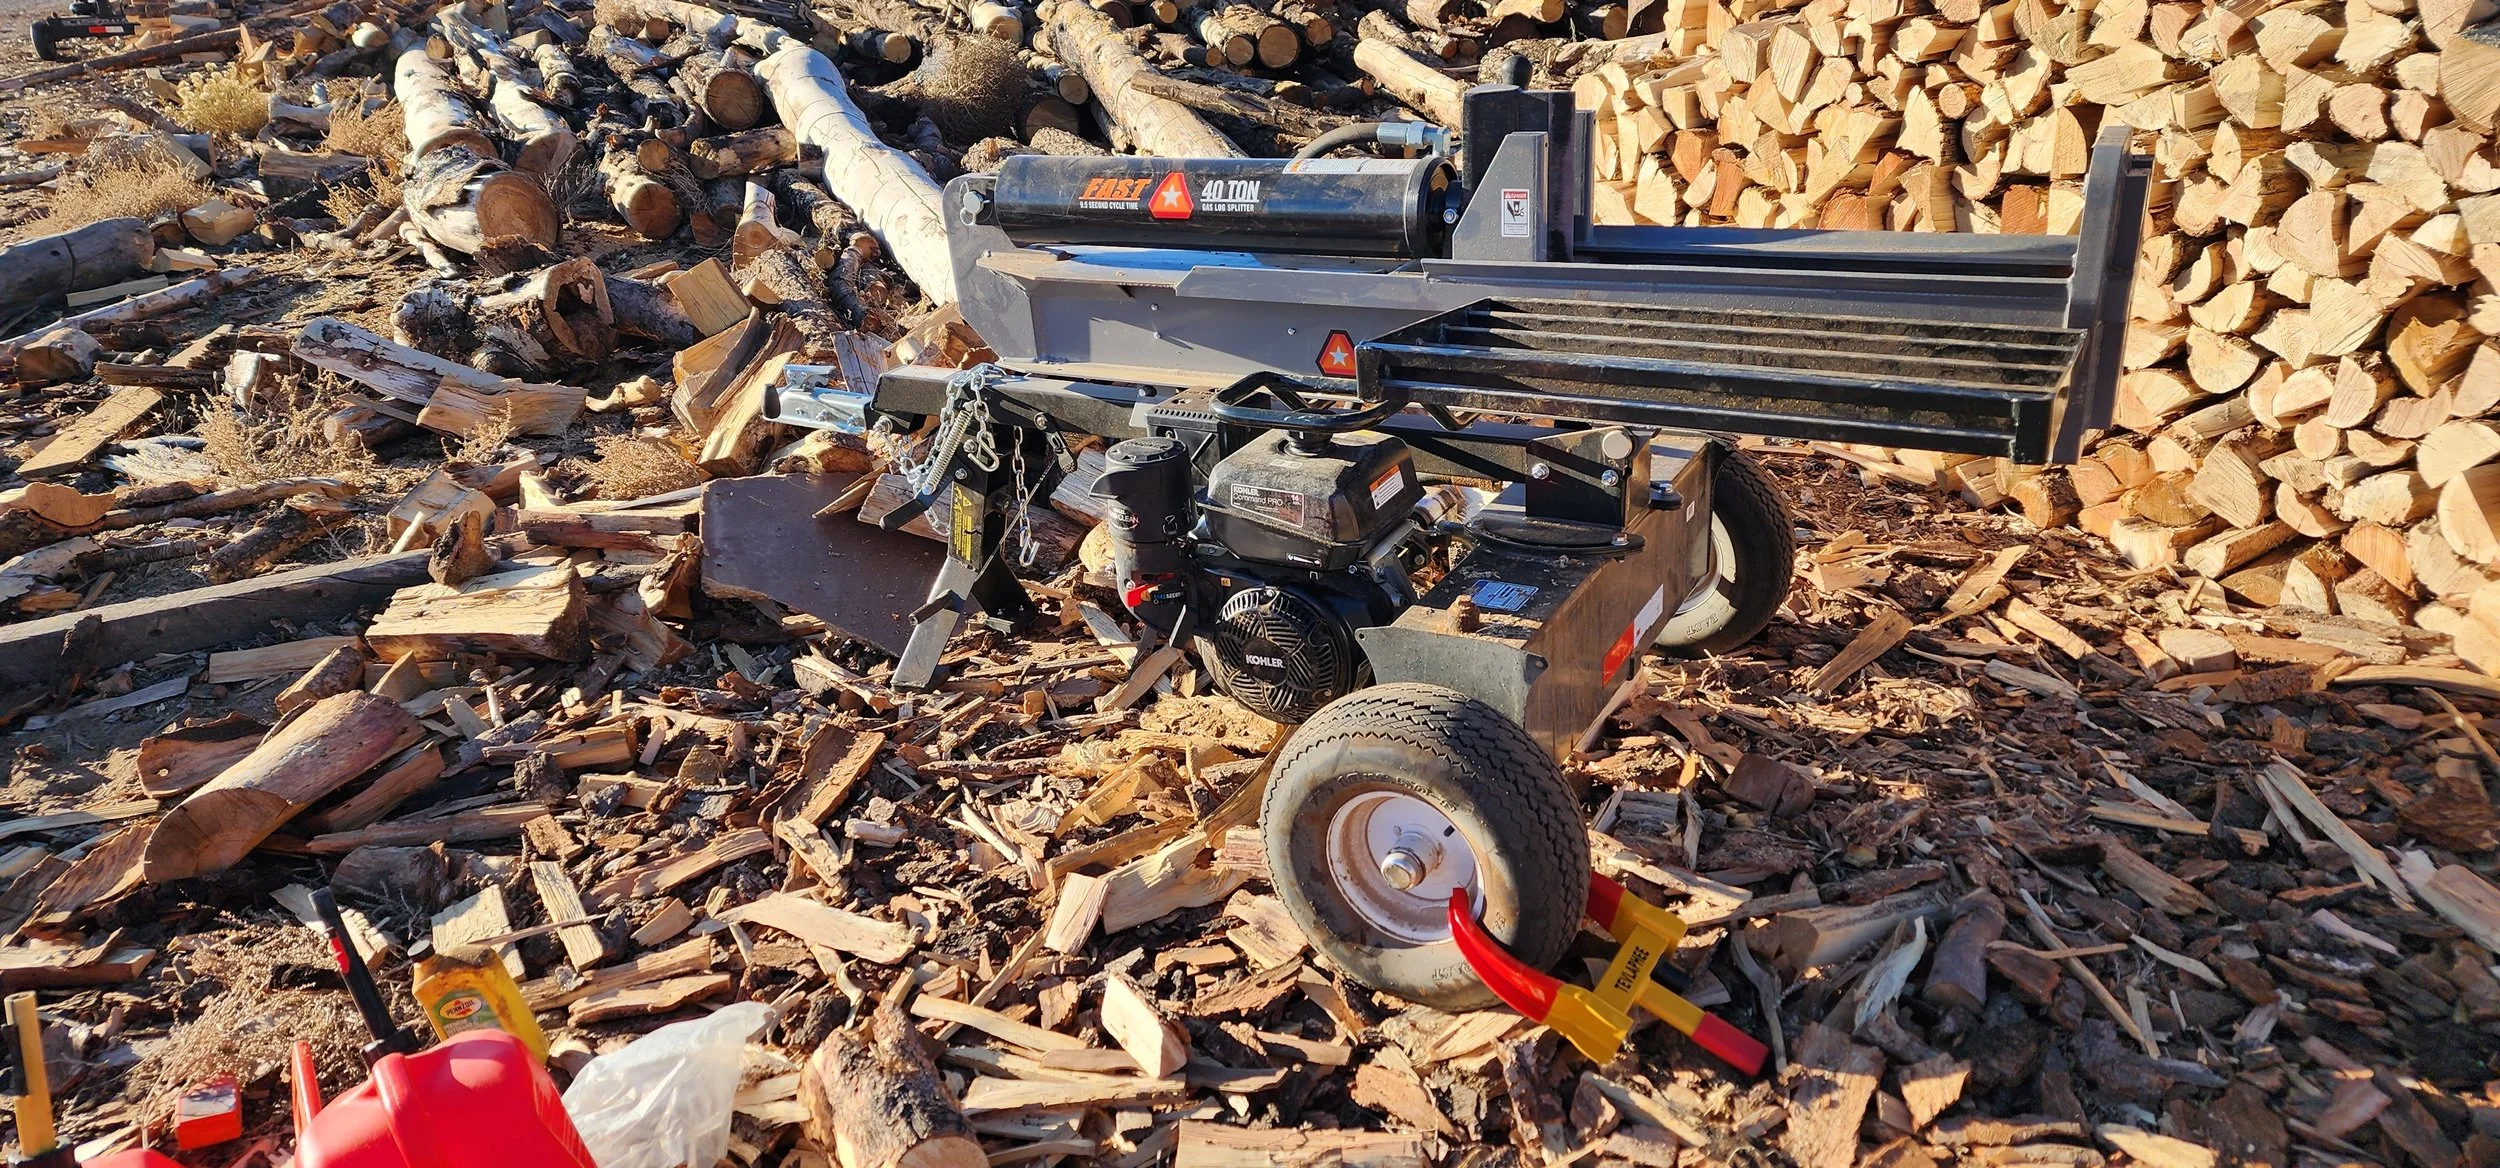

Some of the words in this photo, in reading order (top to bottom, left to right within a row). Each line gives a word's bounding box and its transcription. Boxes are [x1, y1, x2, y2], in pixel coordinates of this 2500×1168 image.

[1082, 178, 1153, 199] FAST
[1201, 180, 1224, 201] 40
[1227, 180, 1260, 202] TON
[1080, 201, 1088, 209] 9.5
[1088, 201, 1109, 209] SECOND
[1109, 201, 1125, 210] CYCLE
[1126, 202, 1138, 210] TIME
[1201, 203, 1213, 212] GAS
[1214, 203, 1226, 212] LOG
[1227, 203, 1255, 212] SPLITTER
[1233, 485, 1259, 496] KOHLER
[1233, 493, 1266, 504] Command
[1267, 497, 1283, 506] PRO
[1245, 654, 1284, 668] KOHLER
[1614, 946, 1650, 993] TEVLAPHEE
[445, 999, 476, 1016] PENNZOIL
